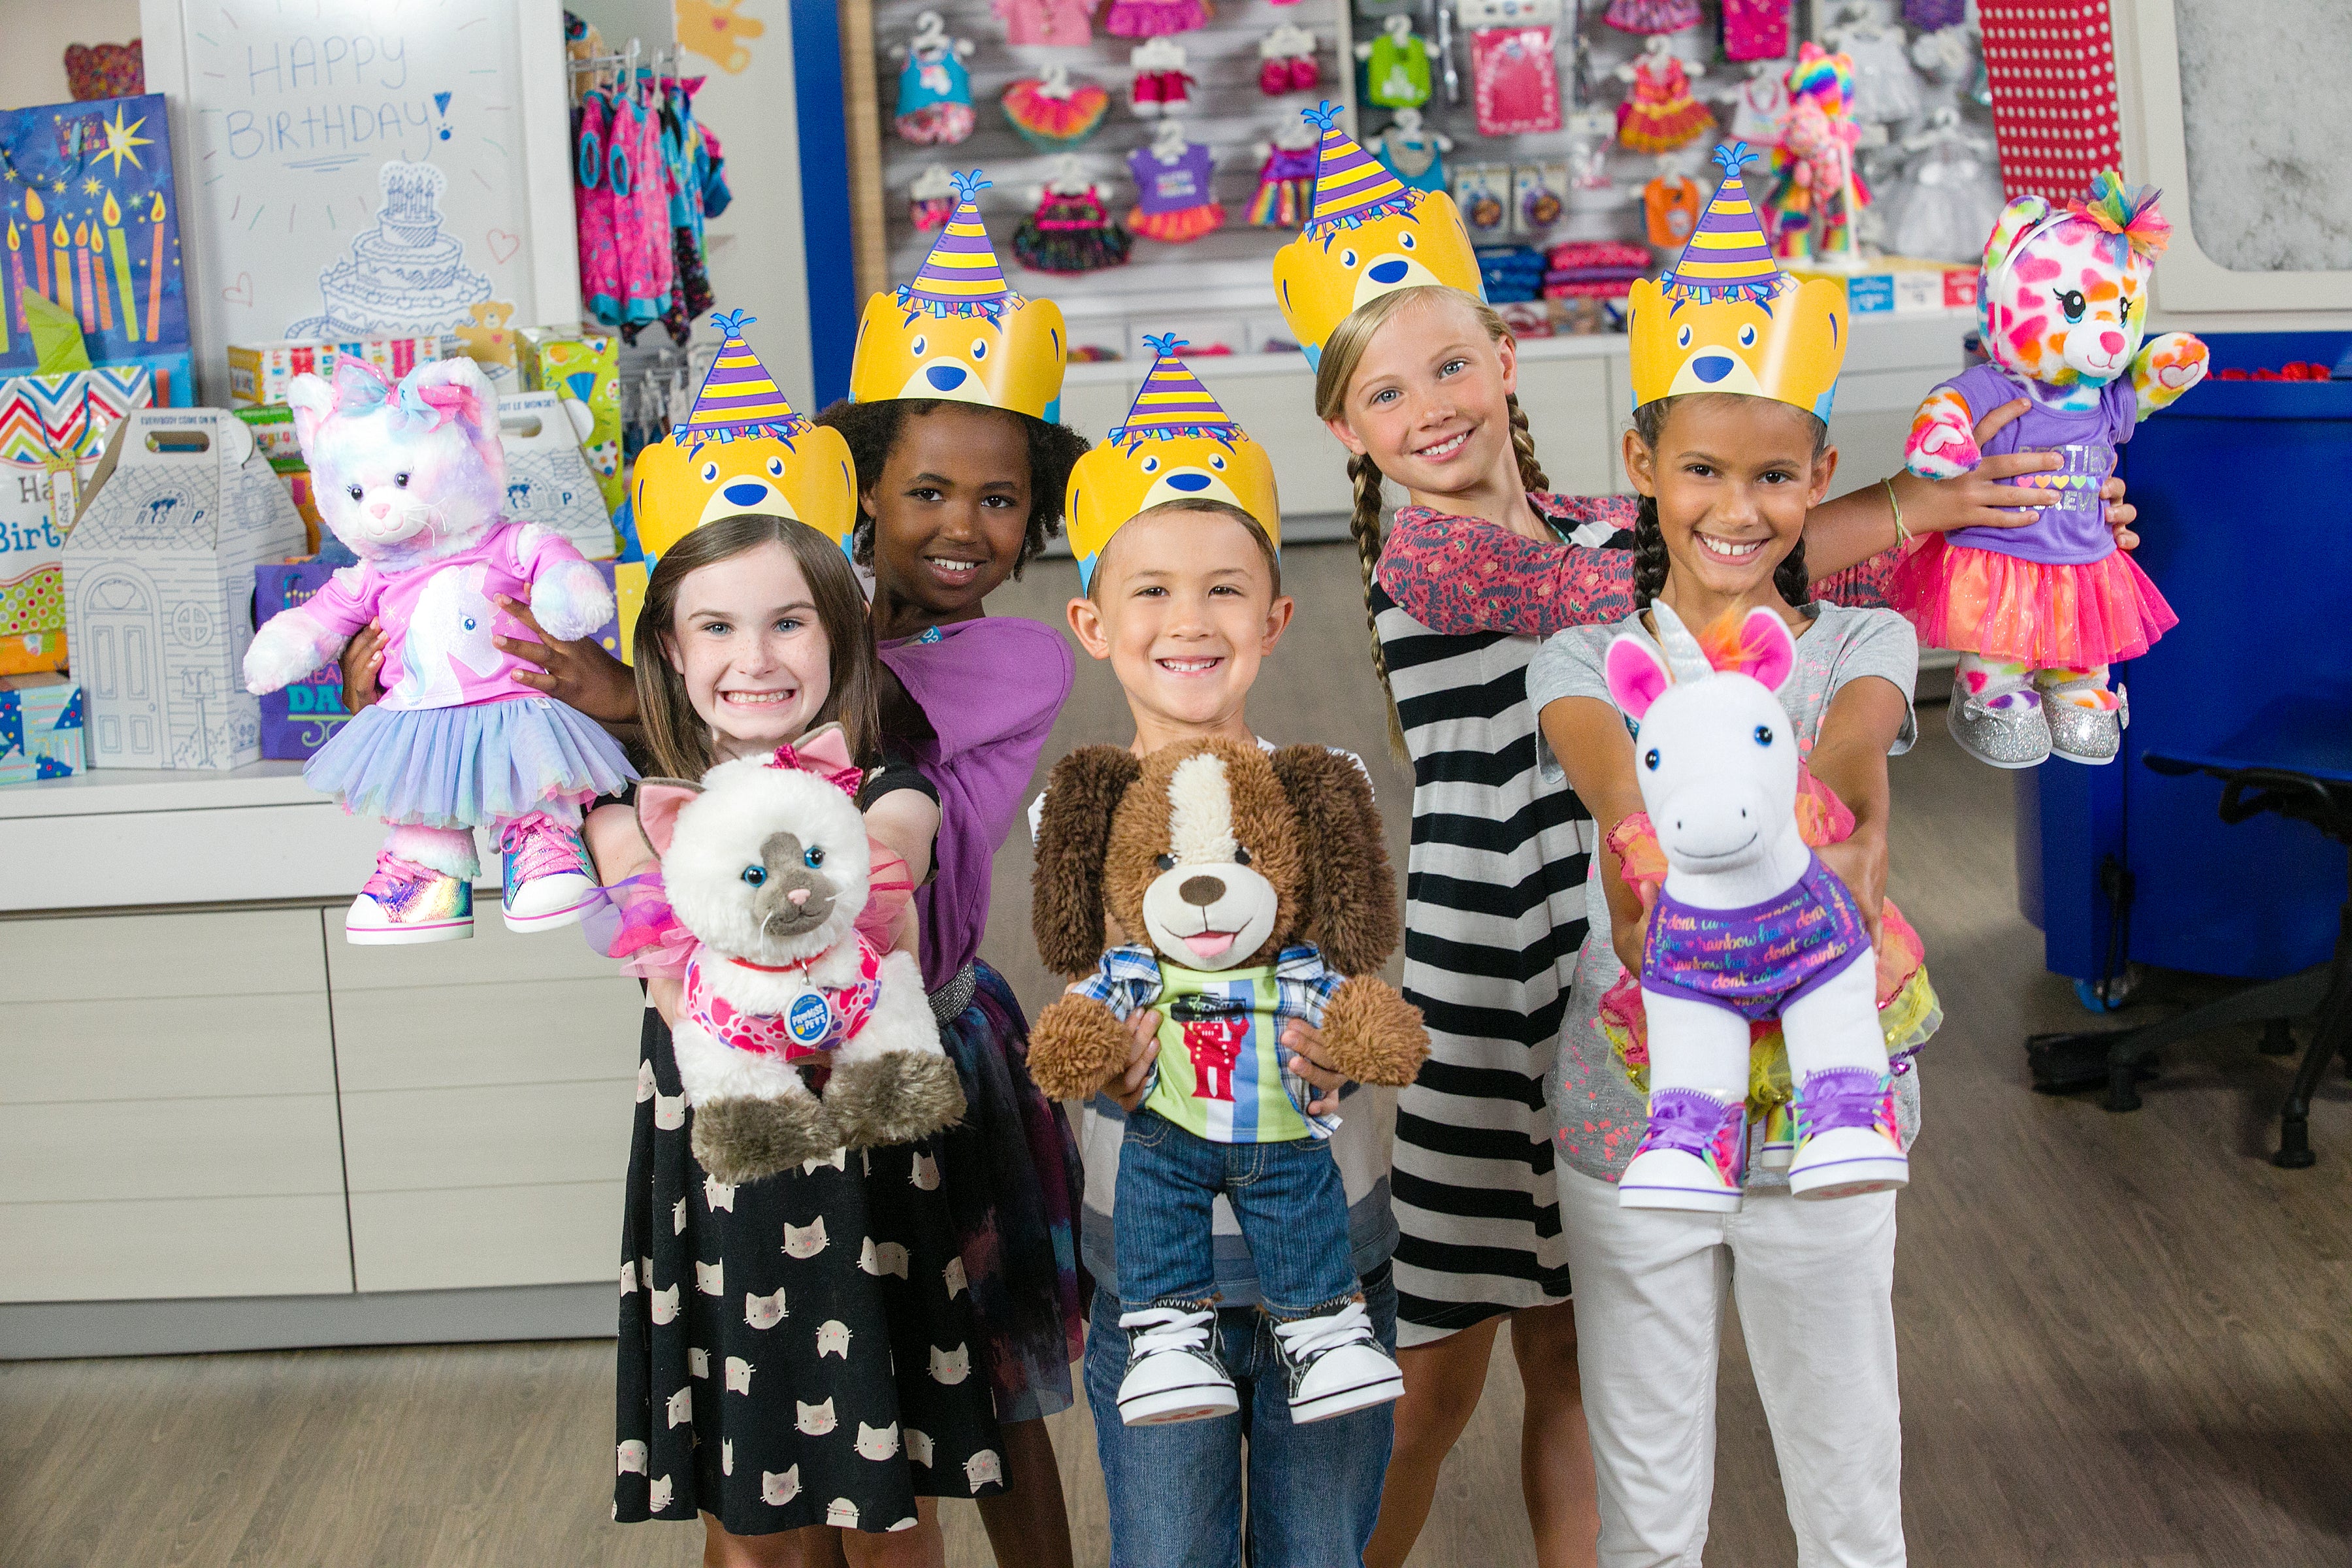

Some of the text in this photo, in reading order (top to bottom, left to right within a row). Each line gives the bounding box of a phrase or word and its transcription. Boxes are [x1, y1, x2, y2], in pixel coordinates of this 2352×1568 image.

[248, 35, 408, 96] HAPPY
[2019, 445, 2110, 472] TIES
[1799, 941, 1848, 968] rainbo
